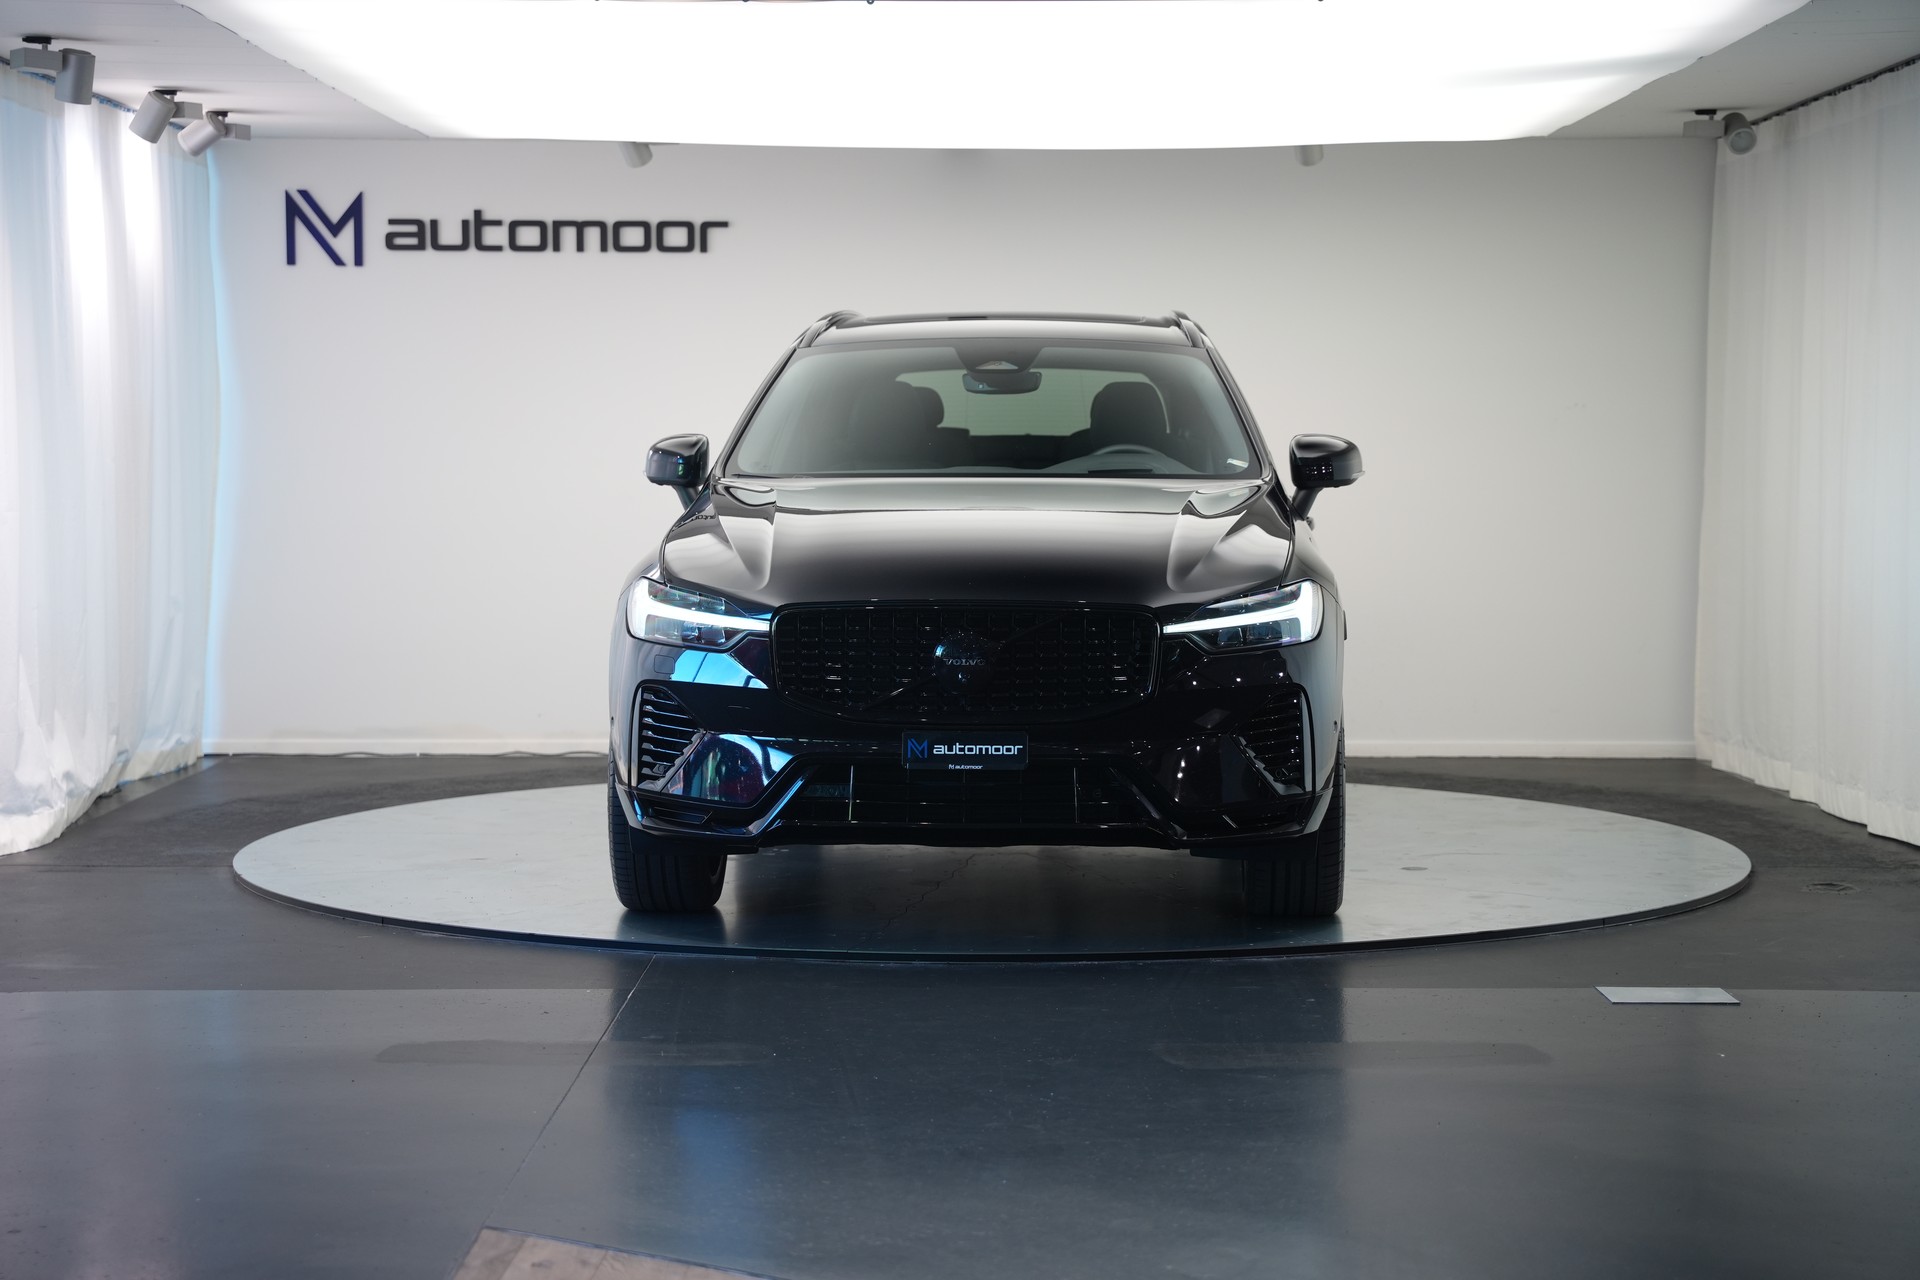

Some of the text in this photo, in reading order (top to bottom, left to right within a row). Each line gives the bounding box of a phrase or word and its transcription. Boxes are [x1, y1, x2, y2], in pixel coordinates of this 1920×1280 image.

[385, 209, 729, 253] automoor
[943, 658, 986, 666] VOLVO
[933, 742, 1023, 755] automoor
